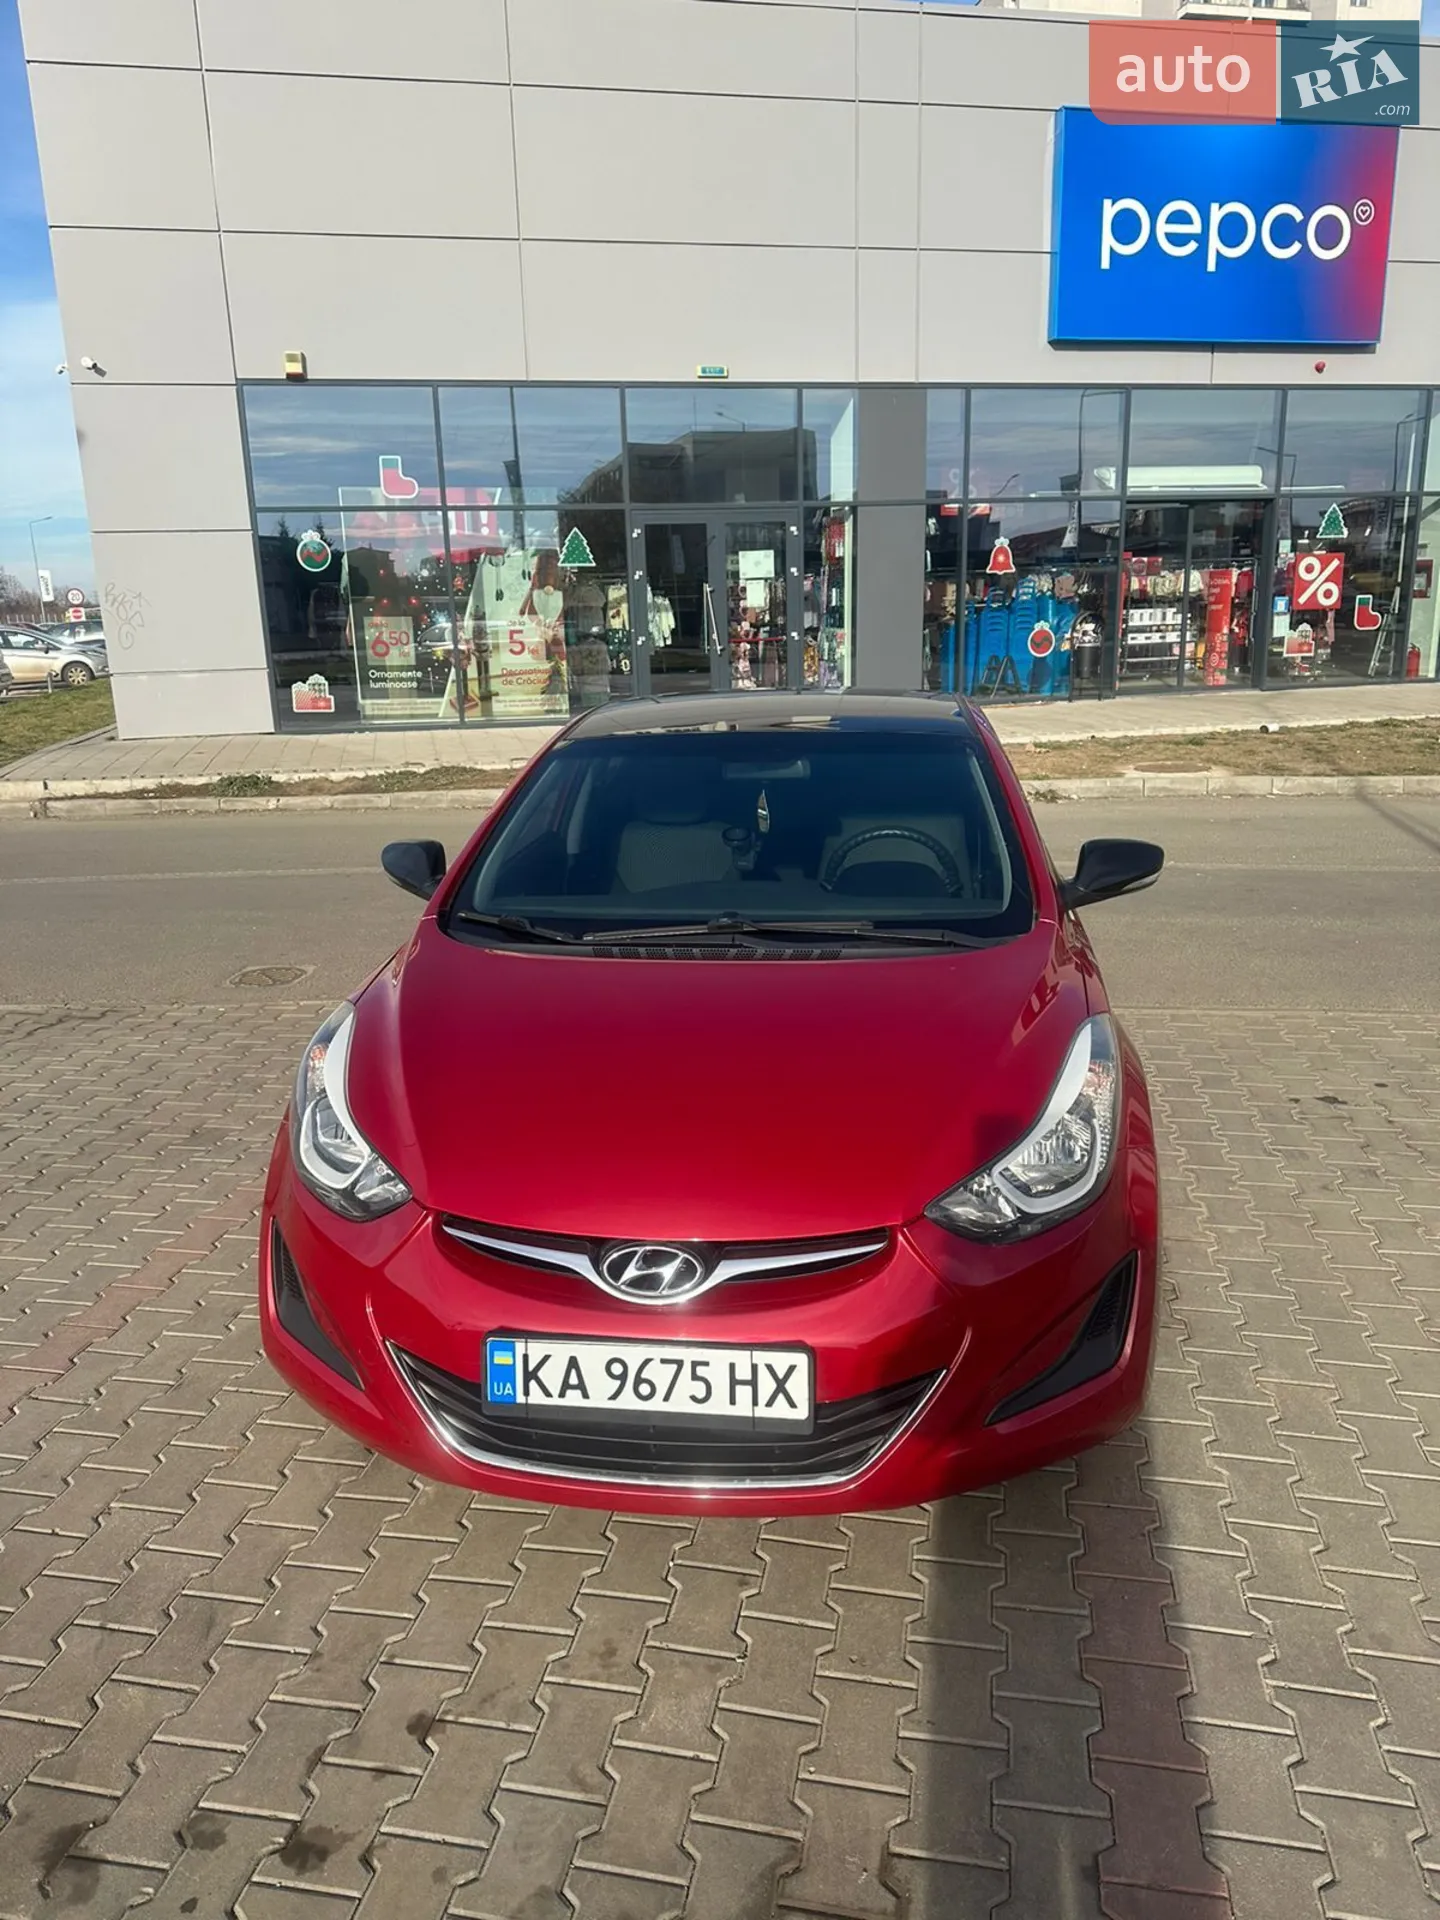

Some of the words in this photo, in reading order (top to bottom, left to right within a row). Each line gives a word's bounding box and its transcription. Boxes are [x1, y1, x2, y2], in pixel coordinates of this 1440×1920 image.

[1100, 197, 1352, 272] pepco
[70, 592, 81, 602] 20
[508, 629, 526, 656] 5
[368, 669, 423, 678] Ornamente
[369, 680, 418, 689] luminoase
[502, 677, 514, 686] de
[522, 1353, 590, 1400] KA
[604, 1357, 713, 1404] 9675
[729, 1362, 798, 1409] HX
[493, 1382, 514, 1397] UA
